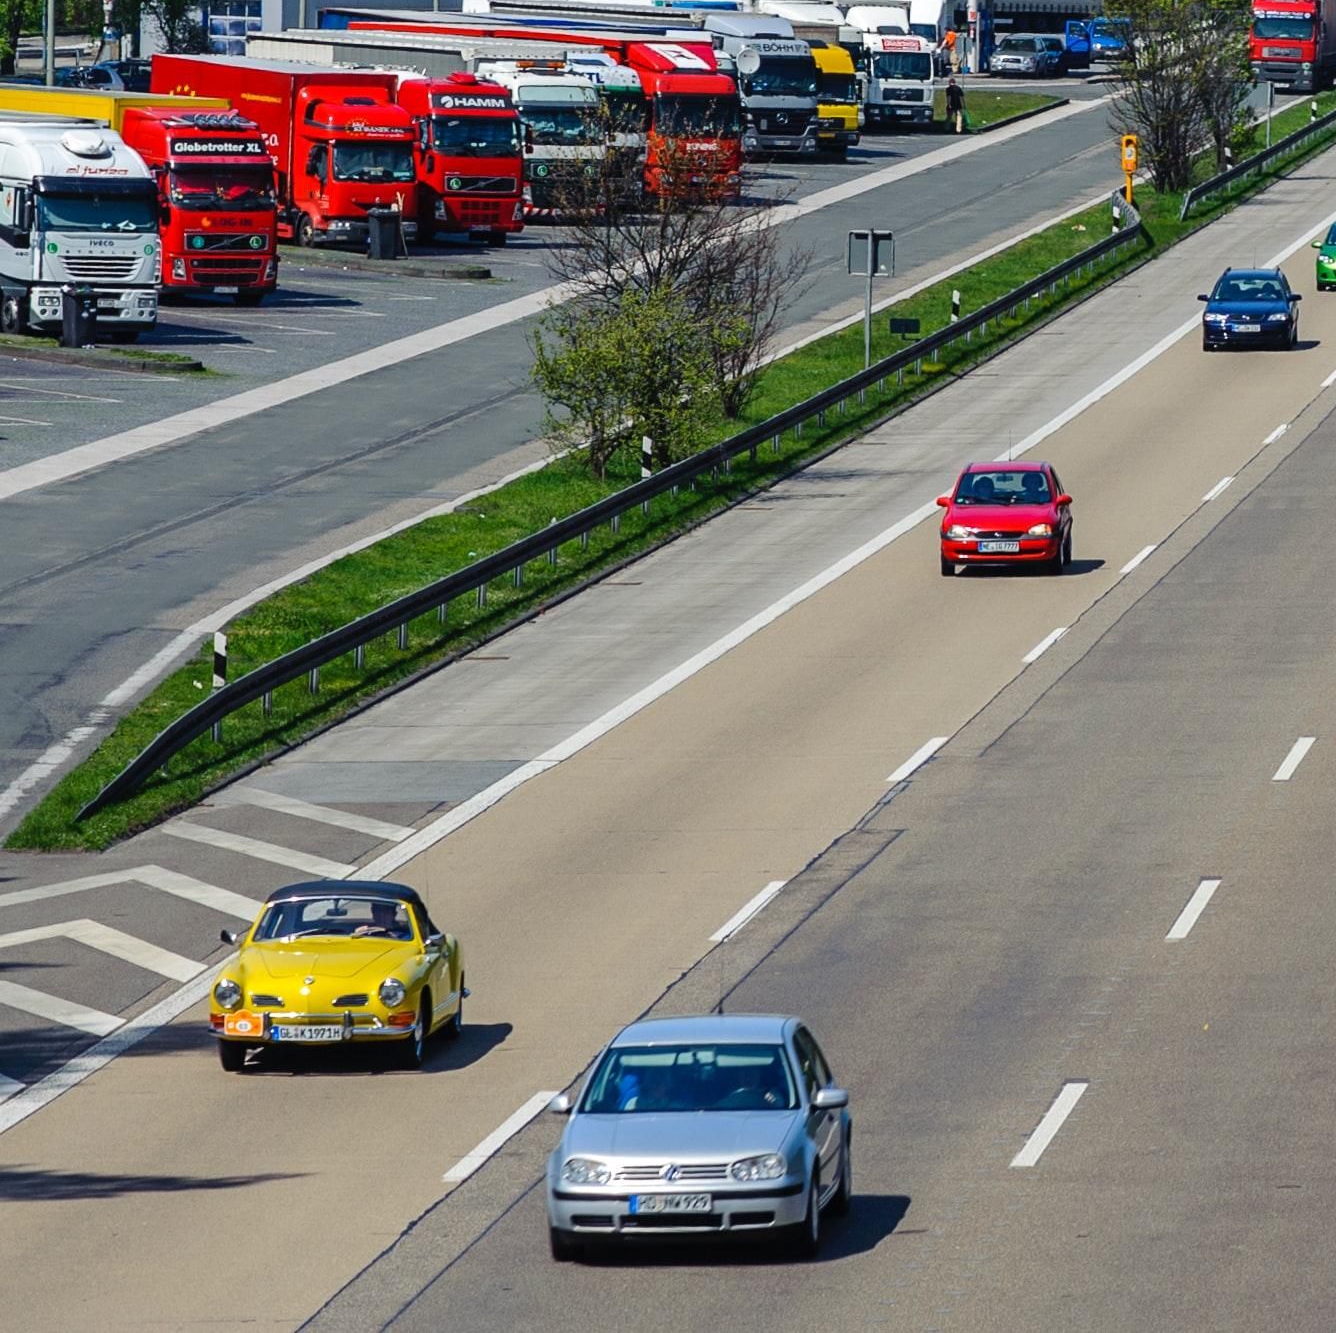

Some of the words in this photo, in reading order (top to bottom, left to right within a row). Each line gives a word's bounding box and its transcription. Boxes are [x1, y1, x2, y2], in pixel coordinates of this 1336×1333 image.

[454, 97, 506, 108] HAMM
[174, 142, 244, 153] Globetrotter
[246, 143, 262, 153] XL
